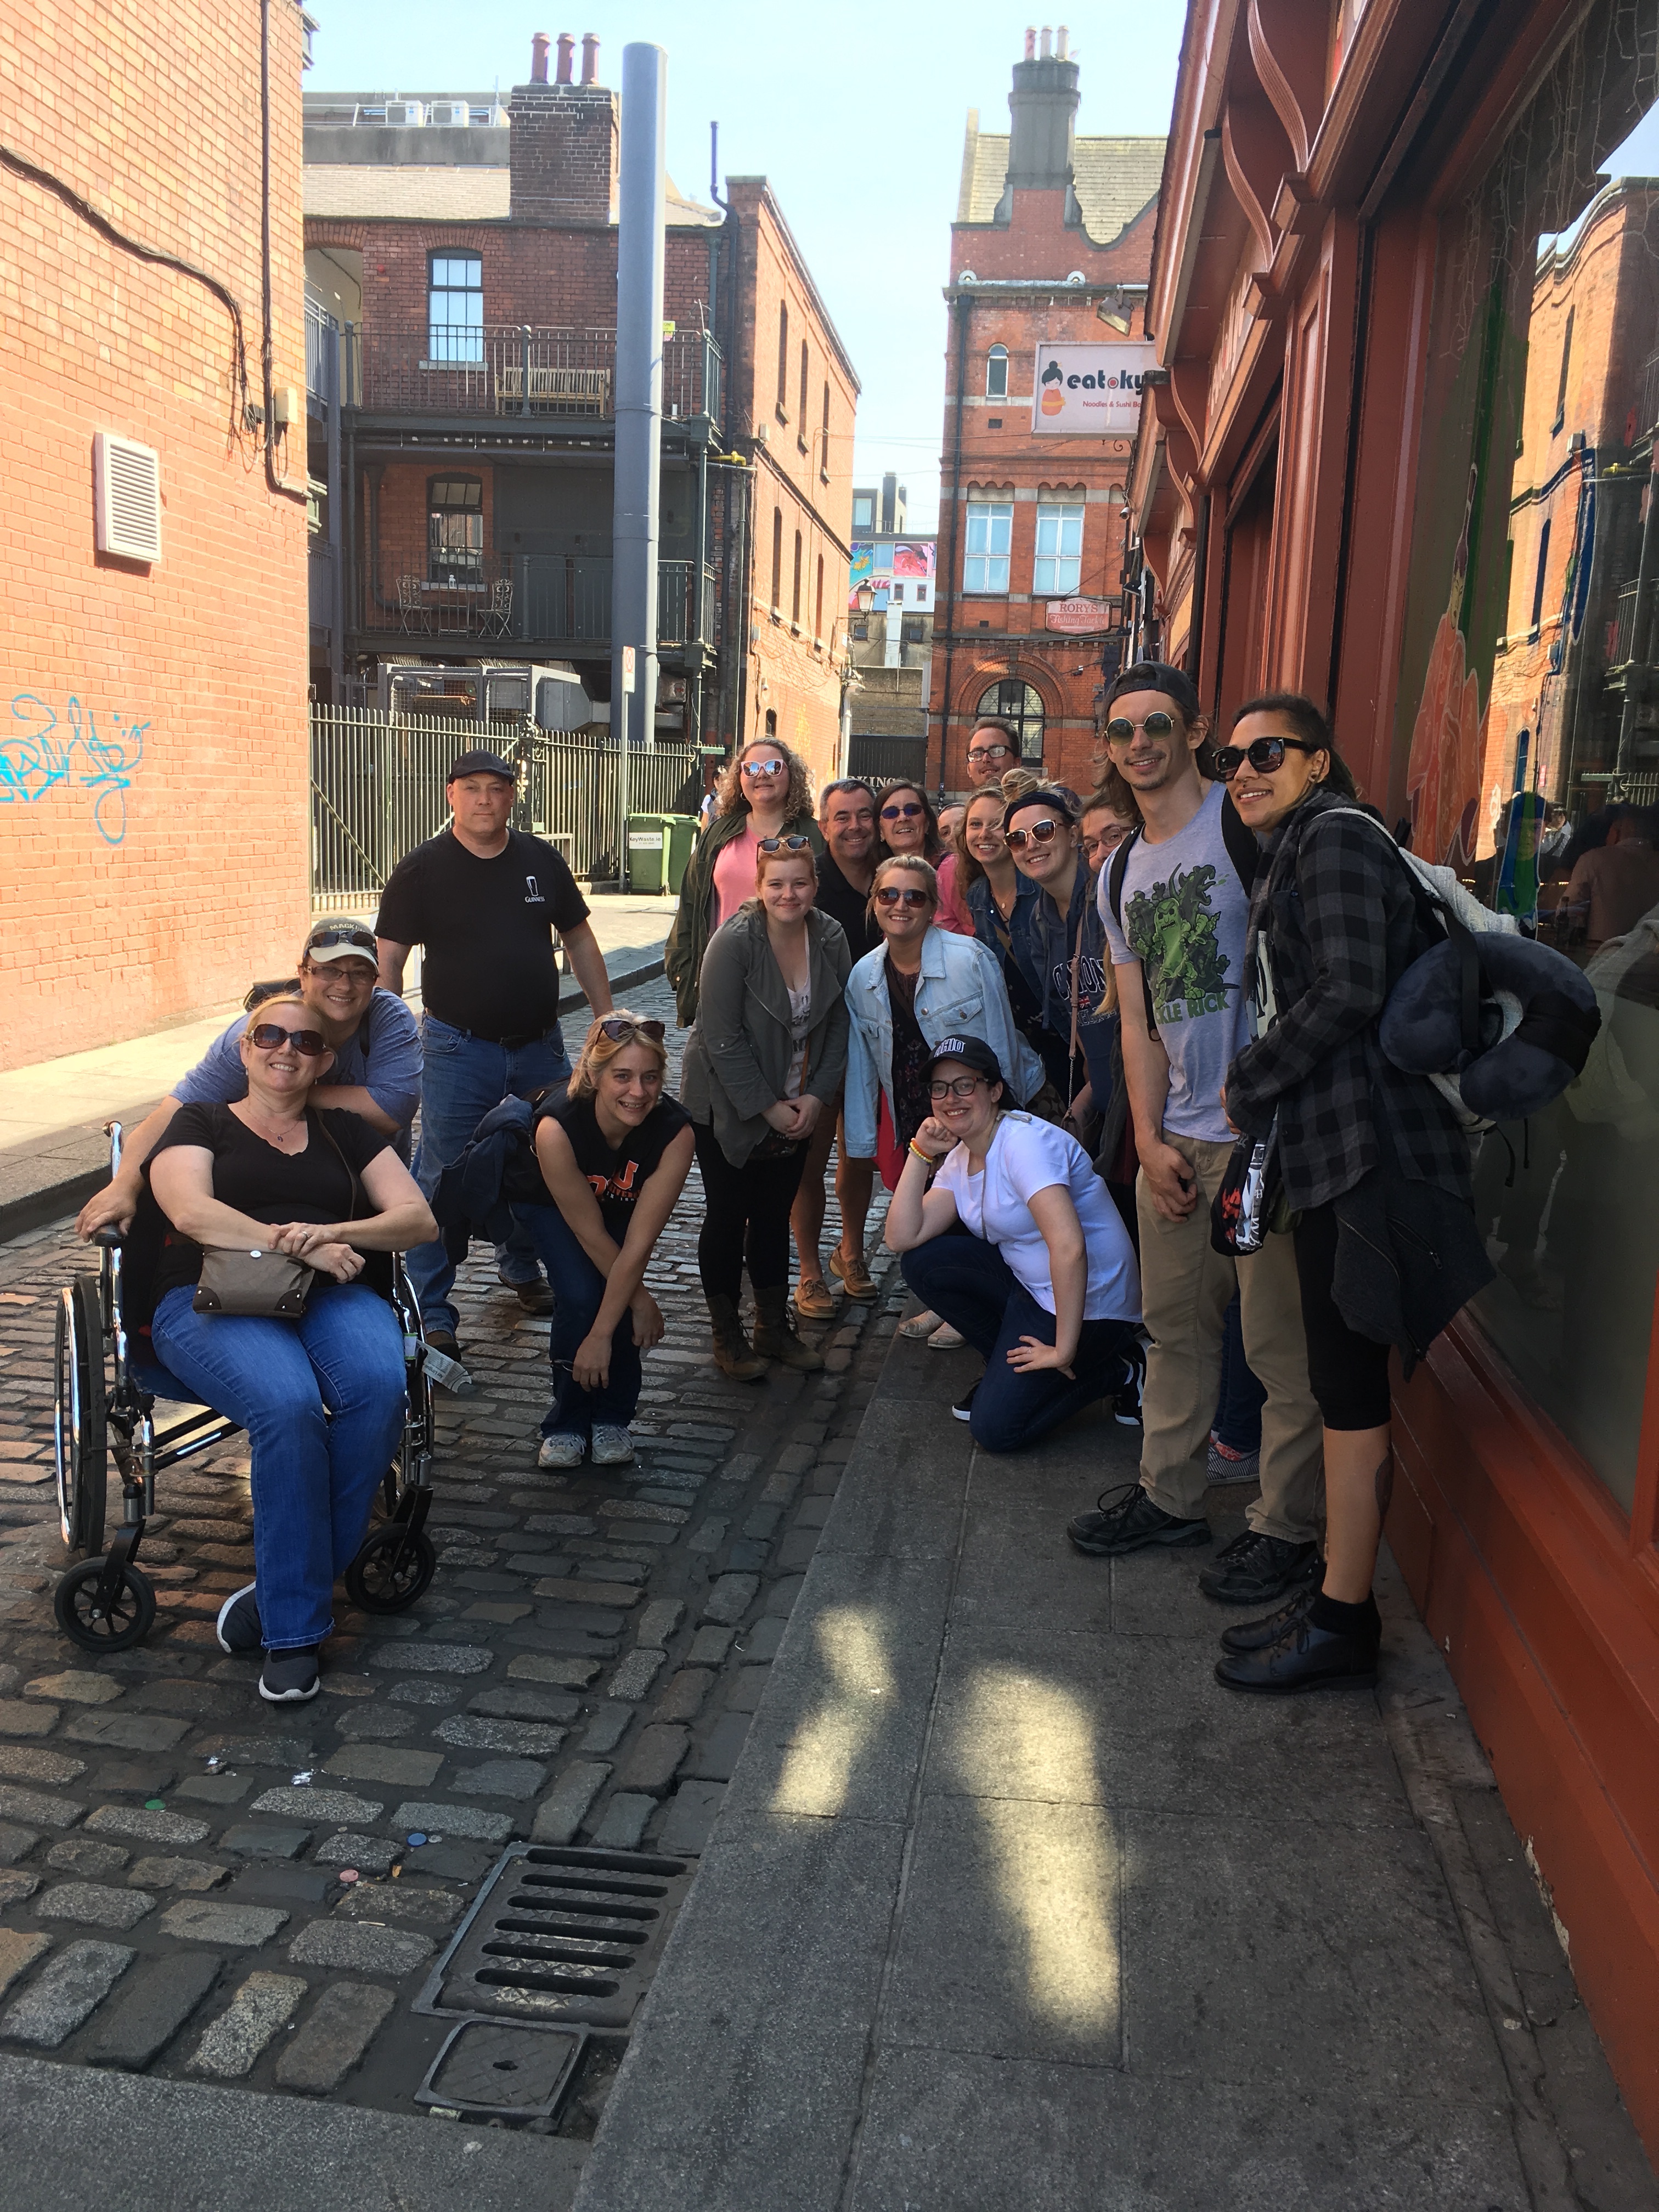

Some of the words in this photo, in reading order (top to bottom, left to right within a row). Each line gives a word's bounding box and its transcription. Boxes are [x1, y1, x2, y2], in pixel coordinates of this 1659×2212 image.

[1059, 603, 1098, 613] RORYS
[1049, 614, 1080, 625] Fishing
[1080, 615, 1105, 625] Tackle
[1187, 990, 1231, 1019] RICK
[934, 1038, 966, 1058] OHIO
